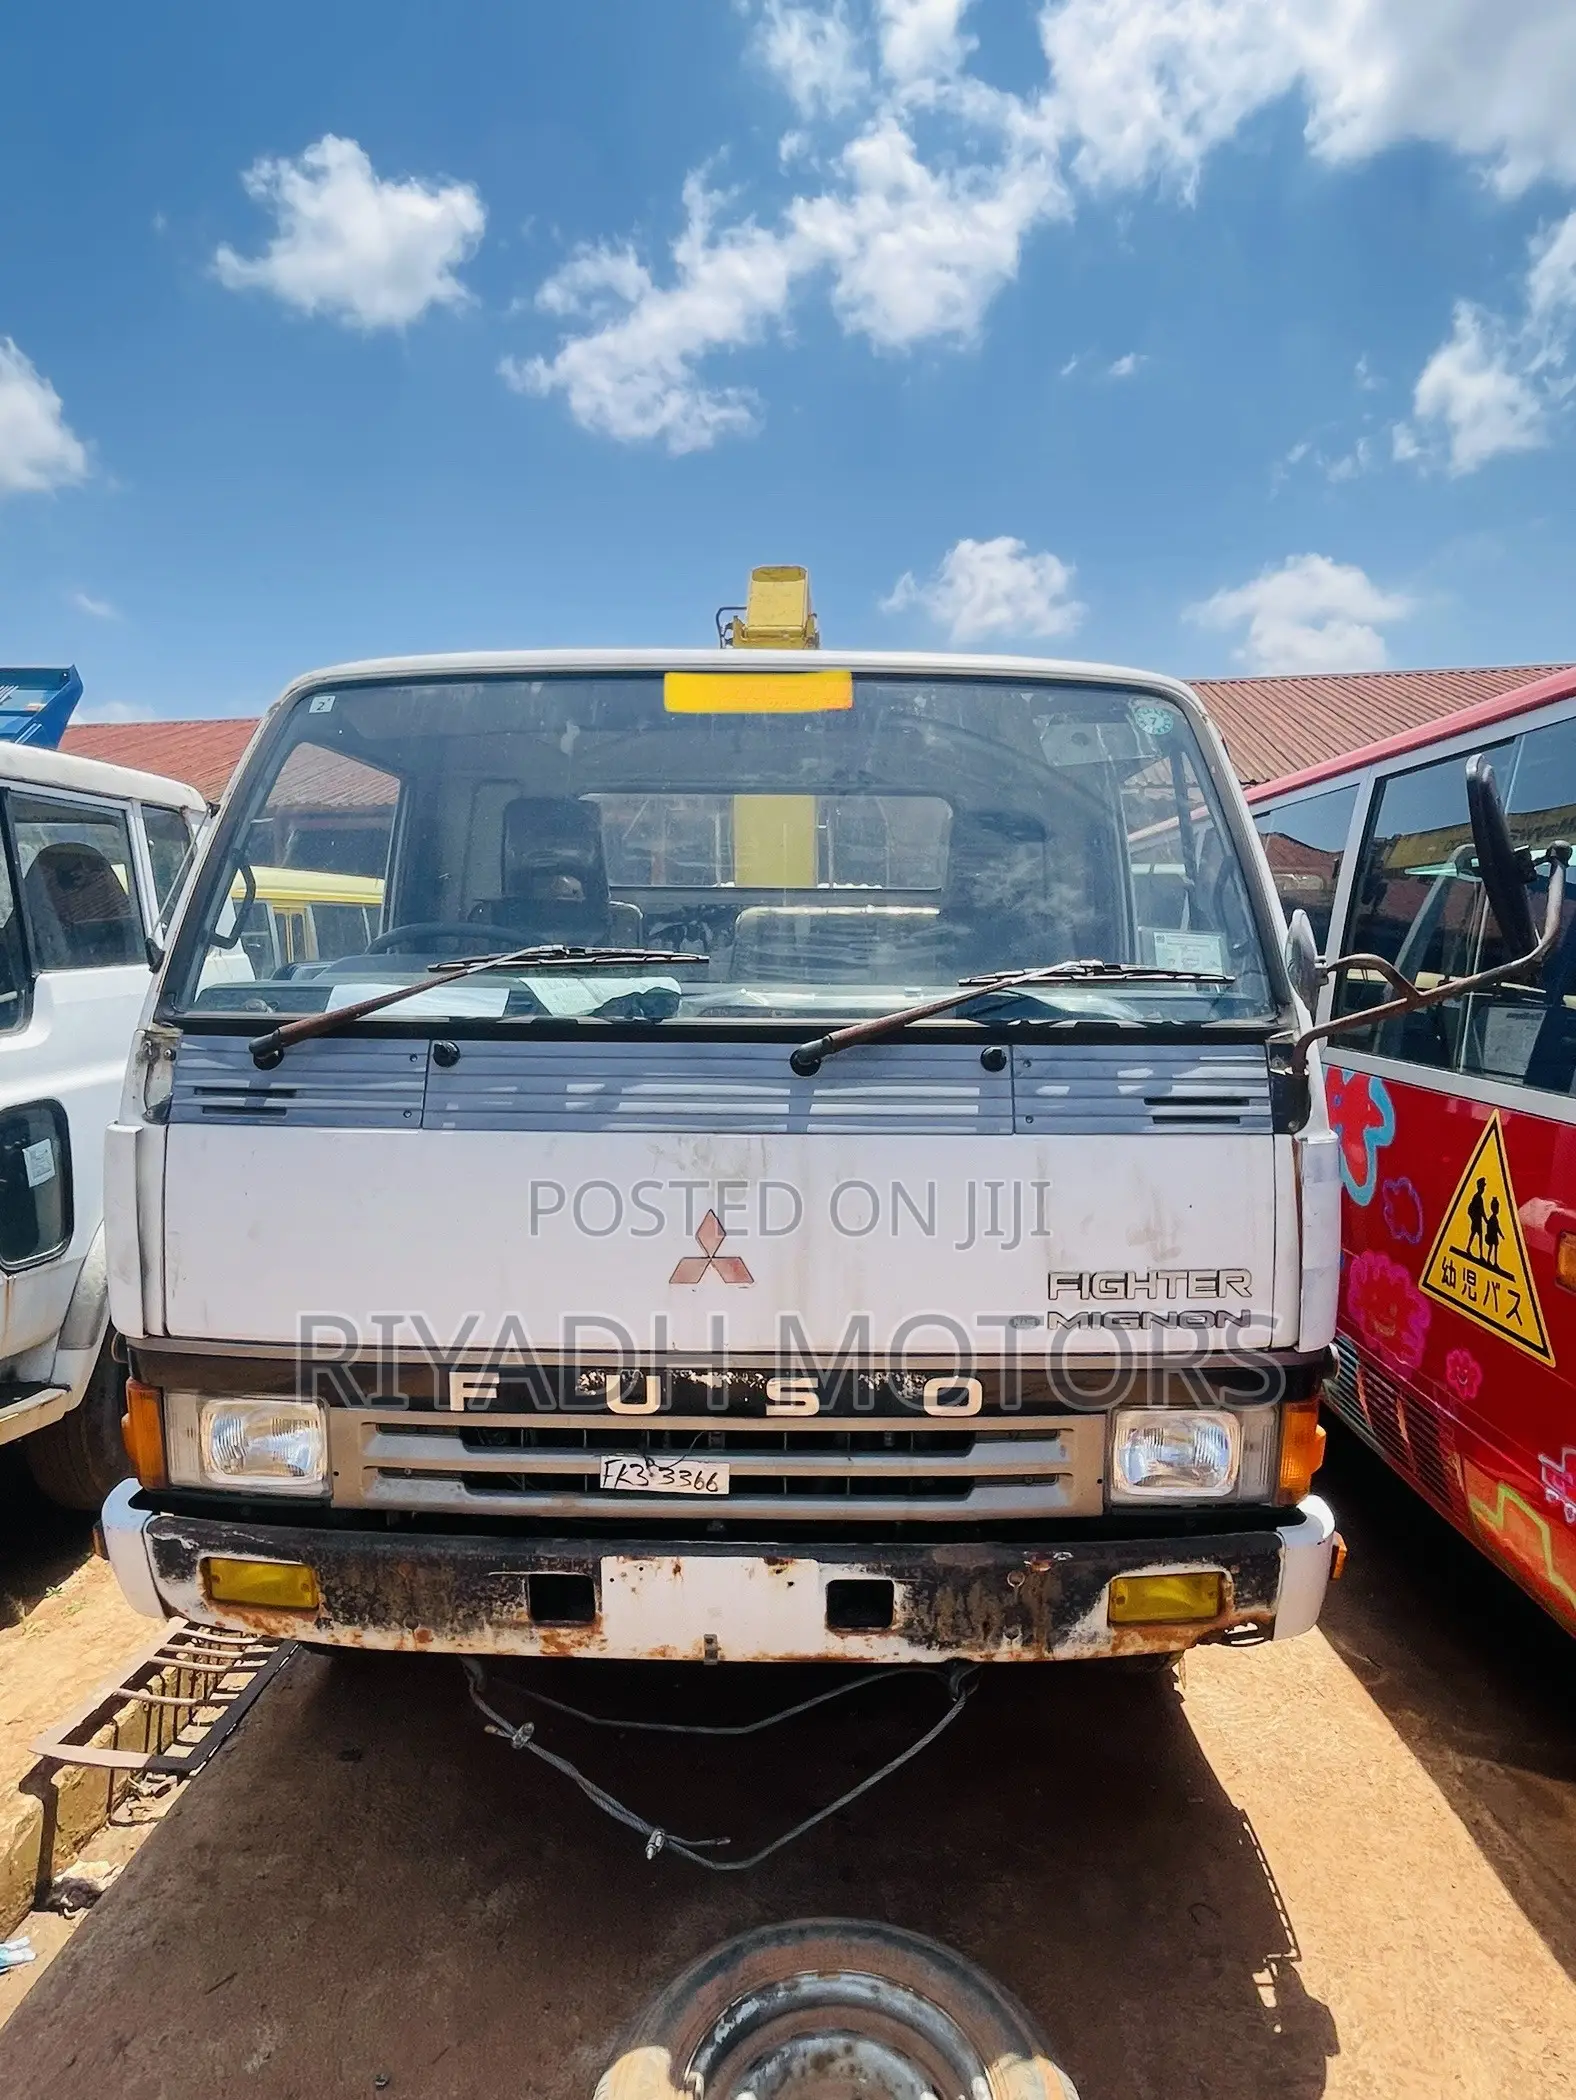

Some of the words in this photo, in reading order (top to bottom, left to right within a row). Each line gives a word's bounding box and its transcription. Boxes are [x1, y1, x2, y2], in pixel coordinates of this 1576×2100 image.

[1047, 1268, 1253, 1300] FIGHTER
[1440, 1255, 1523, 1327] 幼児バス
[1046, 1309, 1251, 1331] MIGNON
[448, 1371, 984, 1417] FUSO
